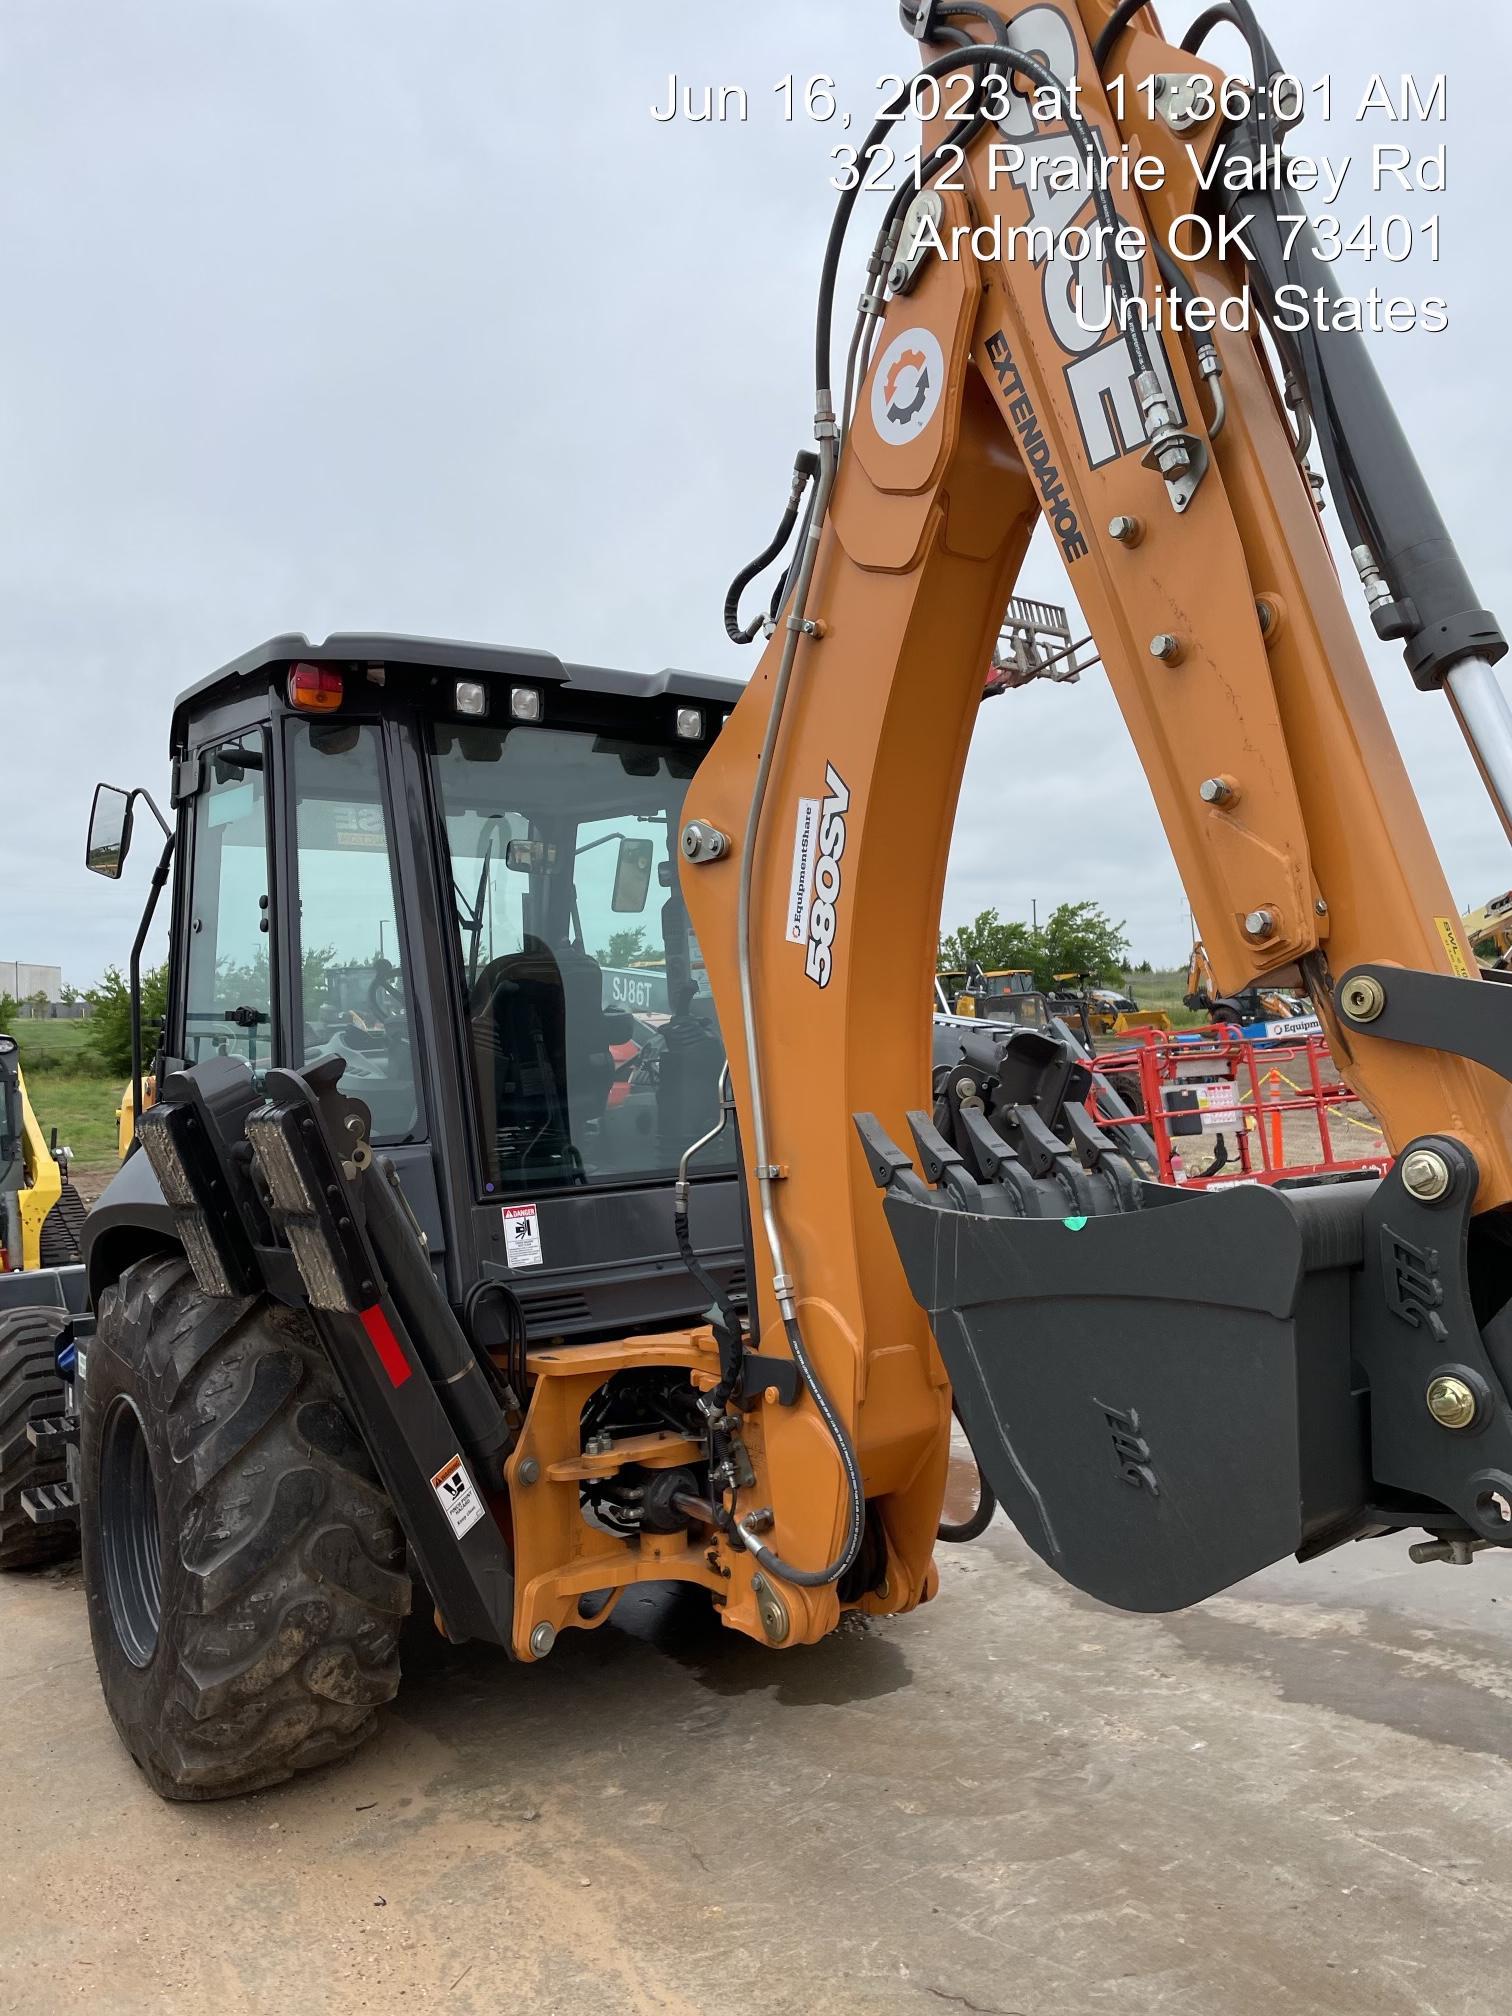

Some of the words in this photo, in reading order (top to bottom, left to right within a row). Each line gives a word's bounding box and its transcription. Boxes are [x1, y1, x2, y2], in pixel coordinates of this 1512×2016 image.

[984, 329, 1089, 564] EXTENDAHOE
[793, 805, 813, 923] EquipmentShare
[804, 758, 850, 990] 580SV
[612, 976, 652, 1007] SJ86T
[512, 1208, 535, 1218] DANGER
